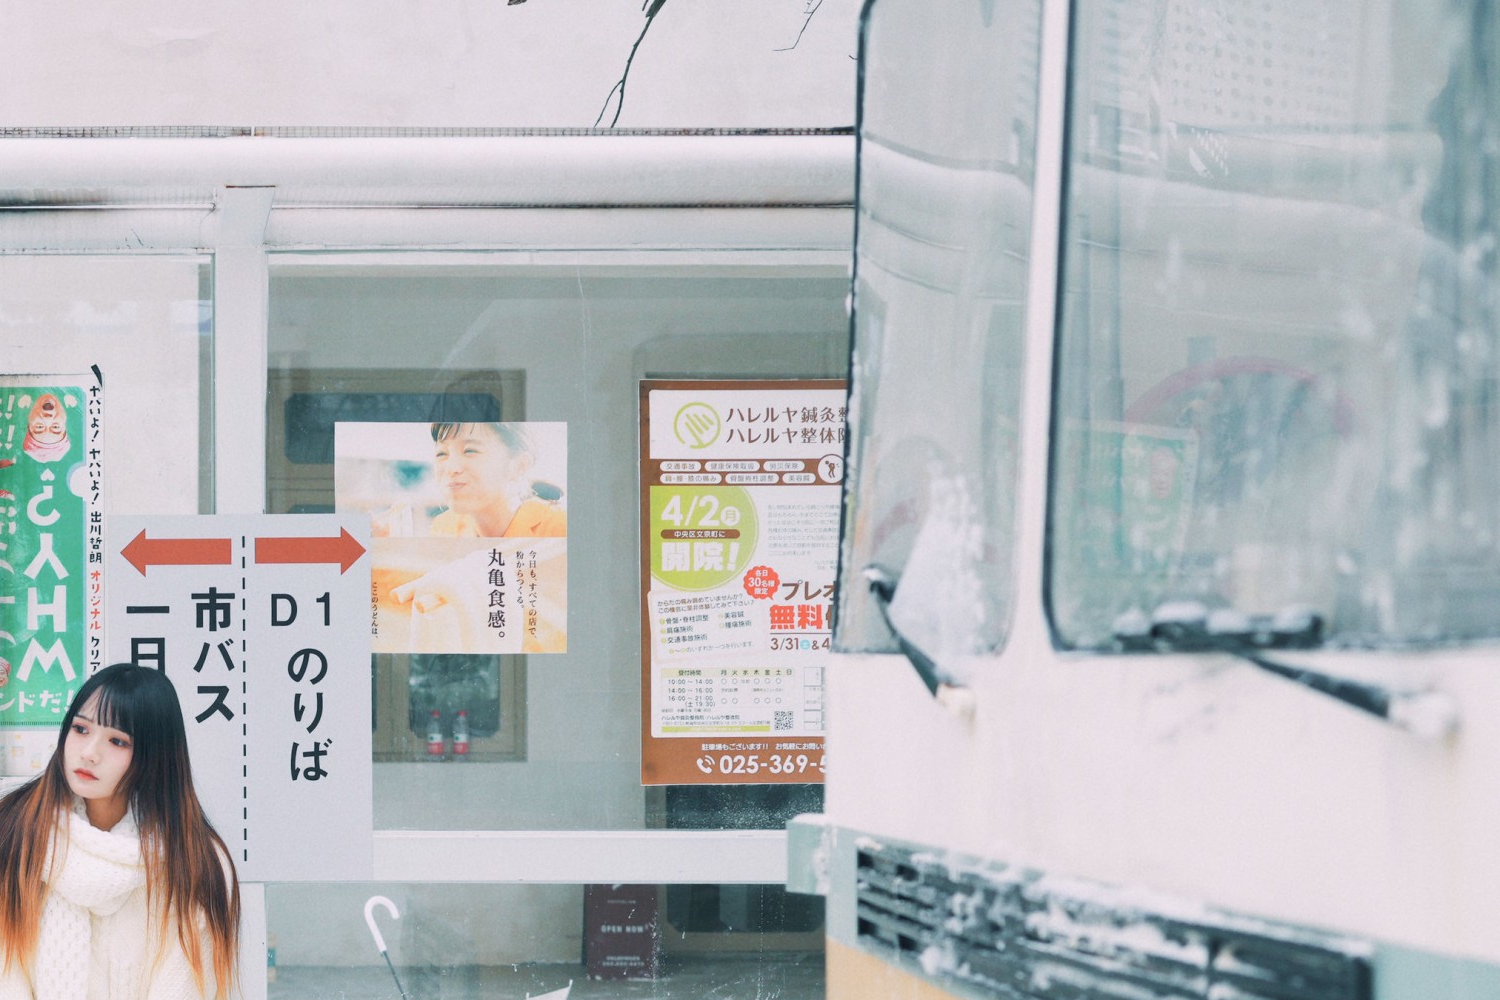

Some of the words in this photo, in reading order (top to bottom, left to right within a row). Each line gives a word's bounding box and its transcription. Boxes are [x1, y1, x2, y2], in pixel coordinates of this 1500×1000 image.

[90, 511, 102, 563] 出川哲朗
[661, 494, 720, 527] 4/2
[487, 548, 506, 639] 丸亀食感。
[191, 587, 235, 723] 市バス
[287, 648, 333, 781] のりば
[601, 925, 622, 933] OPEN
